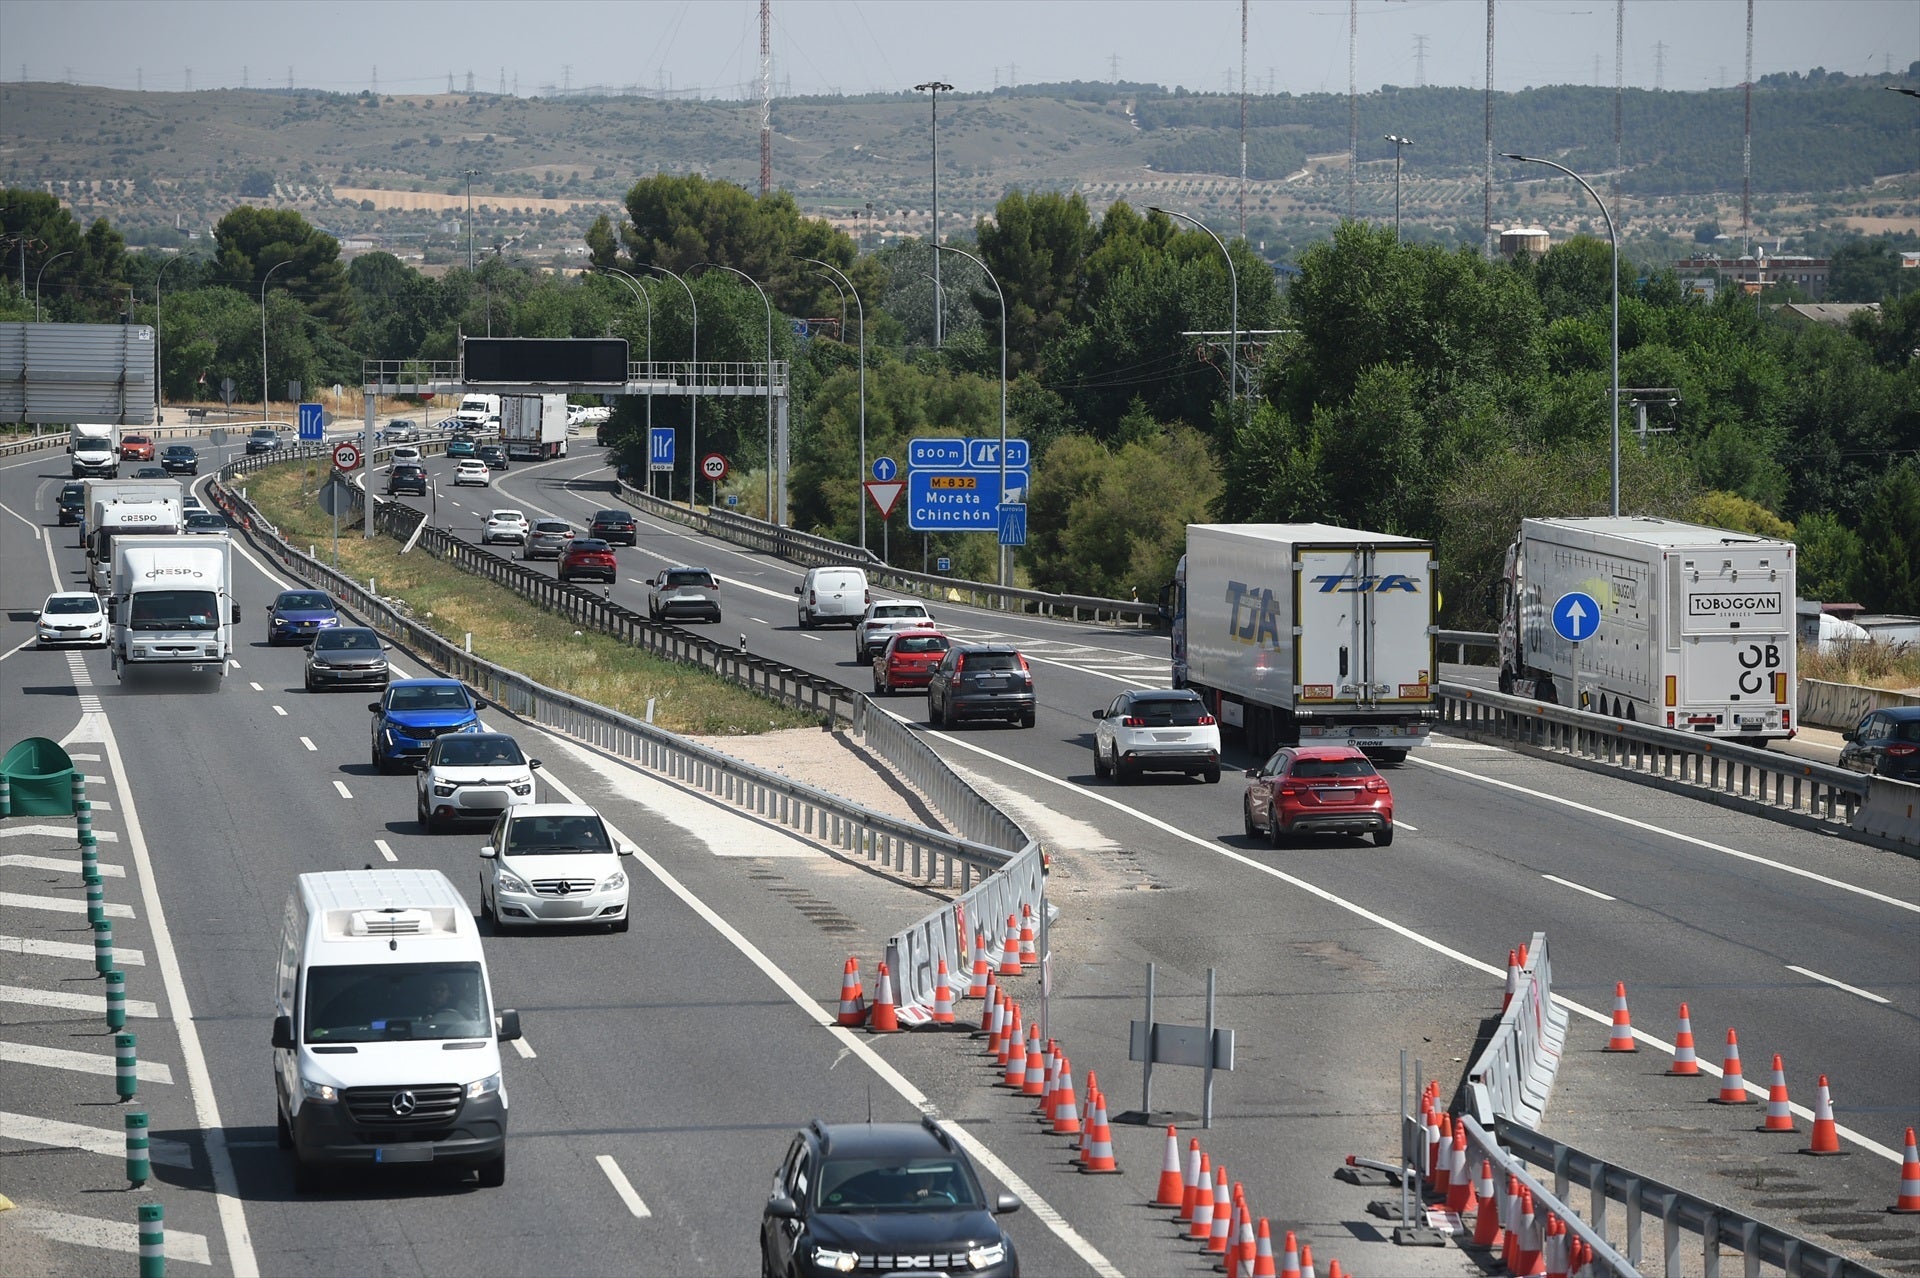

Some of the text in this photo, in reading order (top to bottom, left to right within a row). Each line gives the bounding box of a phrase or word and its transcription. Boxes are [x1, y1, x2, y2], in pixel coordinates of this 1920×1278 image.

[337, 453, 354, 461] 120
[917, 448, 945, 458] 800
[1007, 449, 1021, 459] 21
[706, 462, 722, 471] 120
[932, 479, 975, 488] M-832
[926, 492, 980, 503] Morata
[916, 508, 990, 520] Chinchón
[145, 568, 203, 578] CRESPO
[1309, 575, 1421, 593] TJA
[1694, 597, 1776, 610] TOBOGGAN
[1225, 580, 1281, 653] TJA
